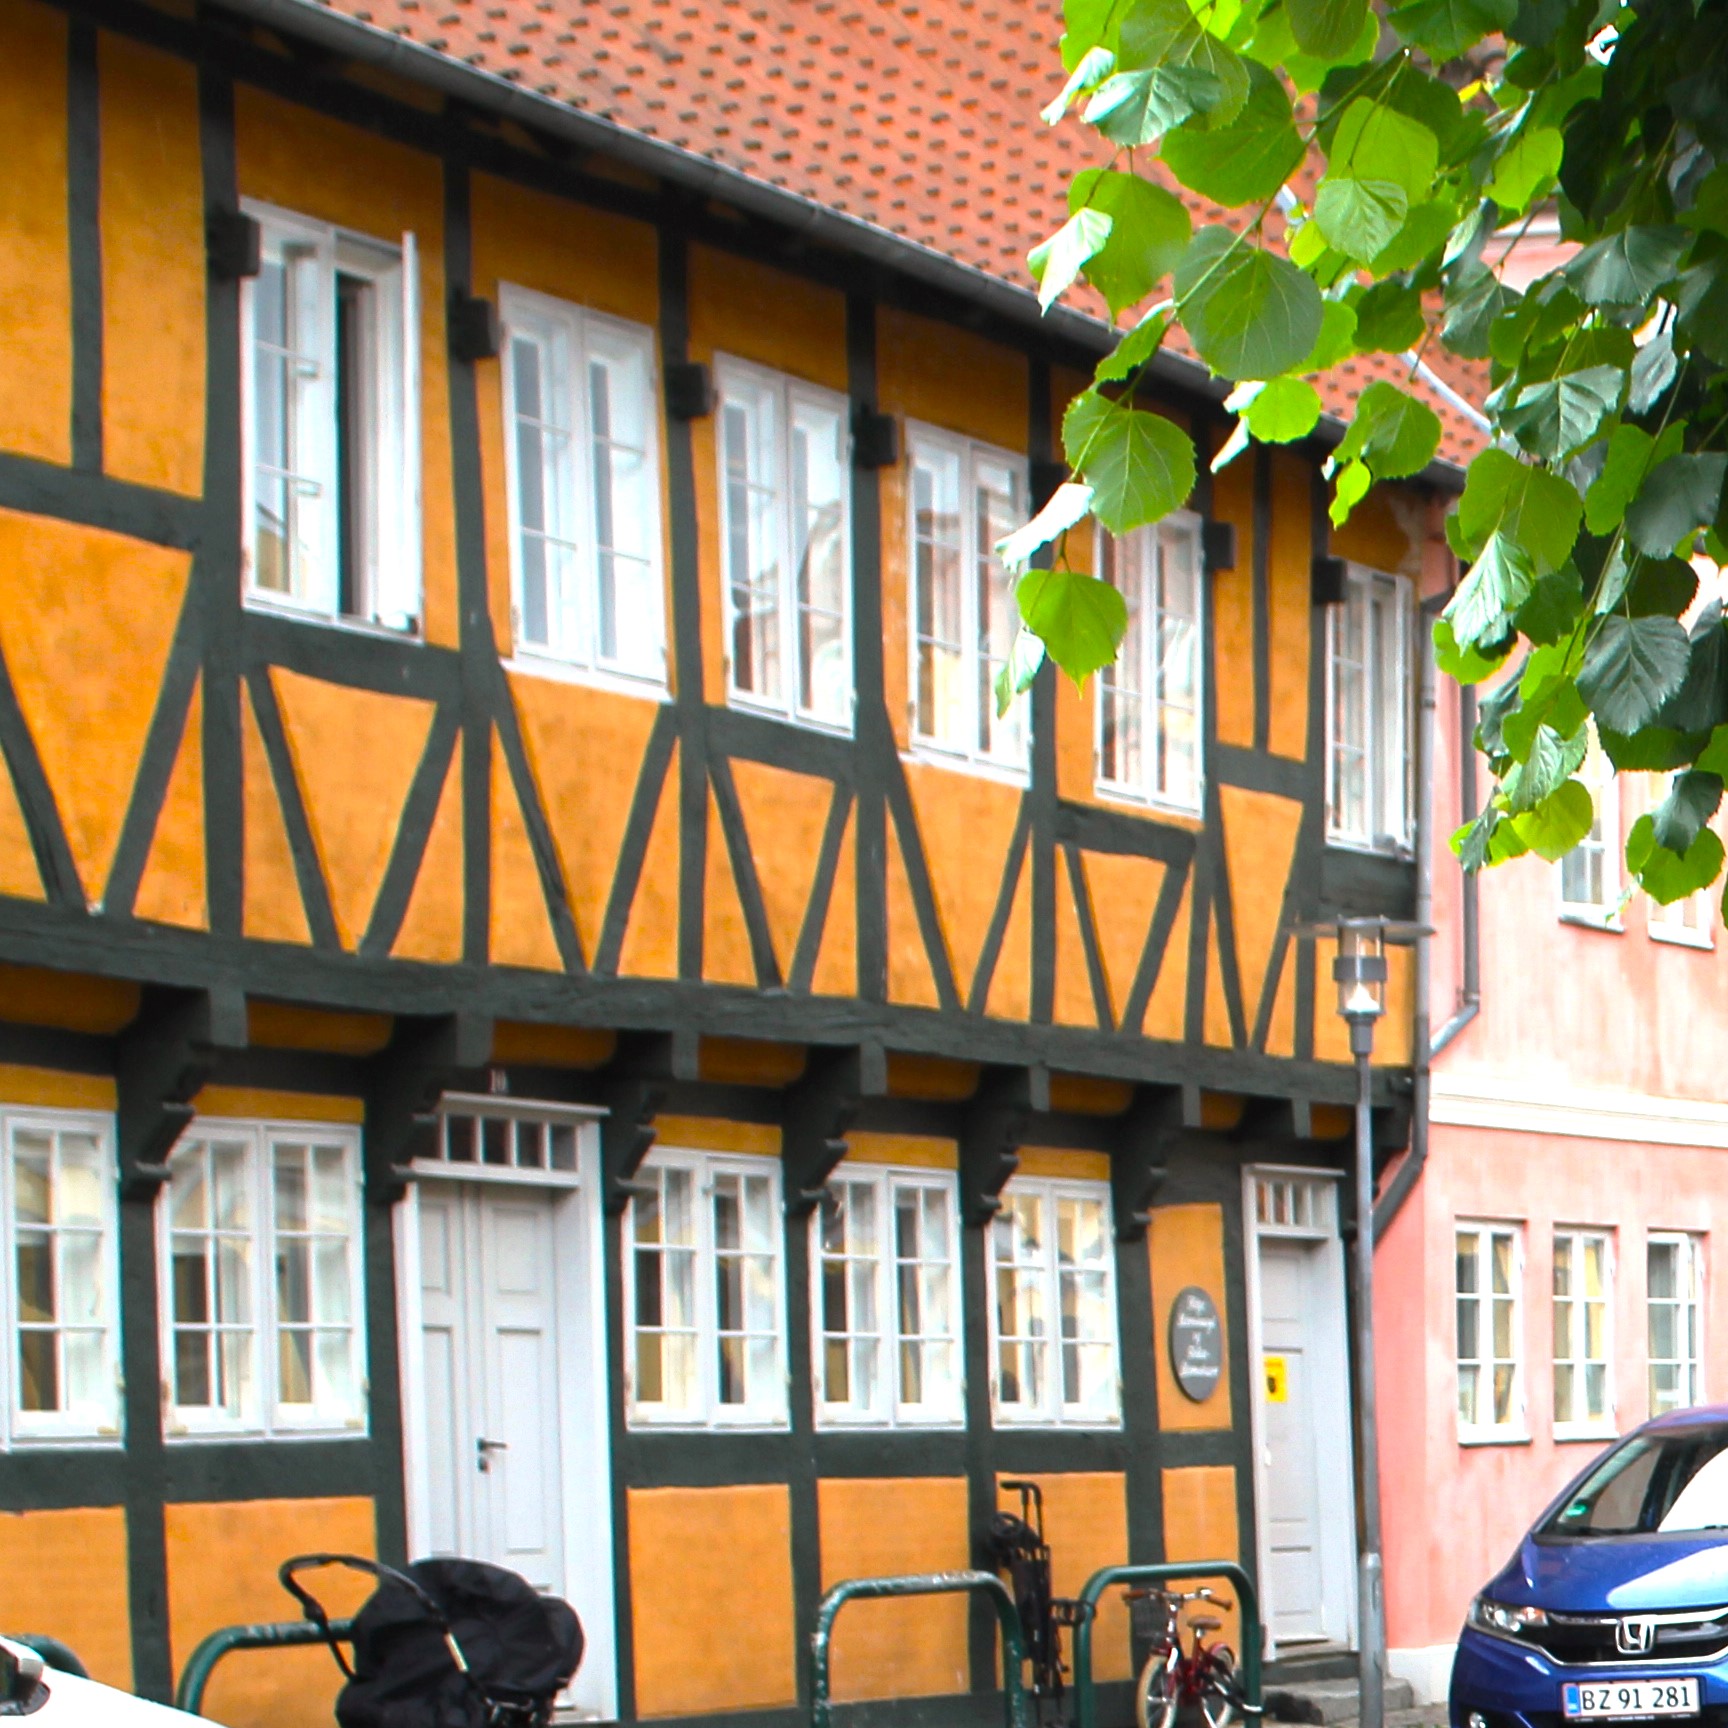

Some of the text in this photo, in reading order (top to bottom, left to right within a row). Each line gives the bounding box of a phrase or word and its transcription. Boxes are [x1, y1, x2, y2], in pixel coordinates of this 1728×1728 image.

[1582, 1686, 1690, 1711] BZ 91 281
